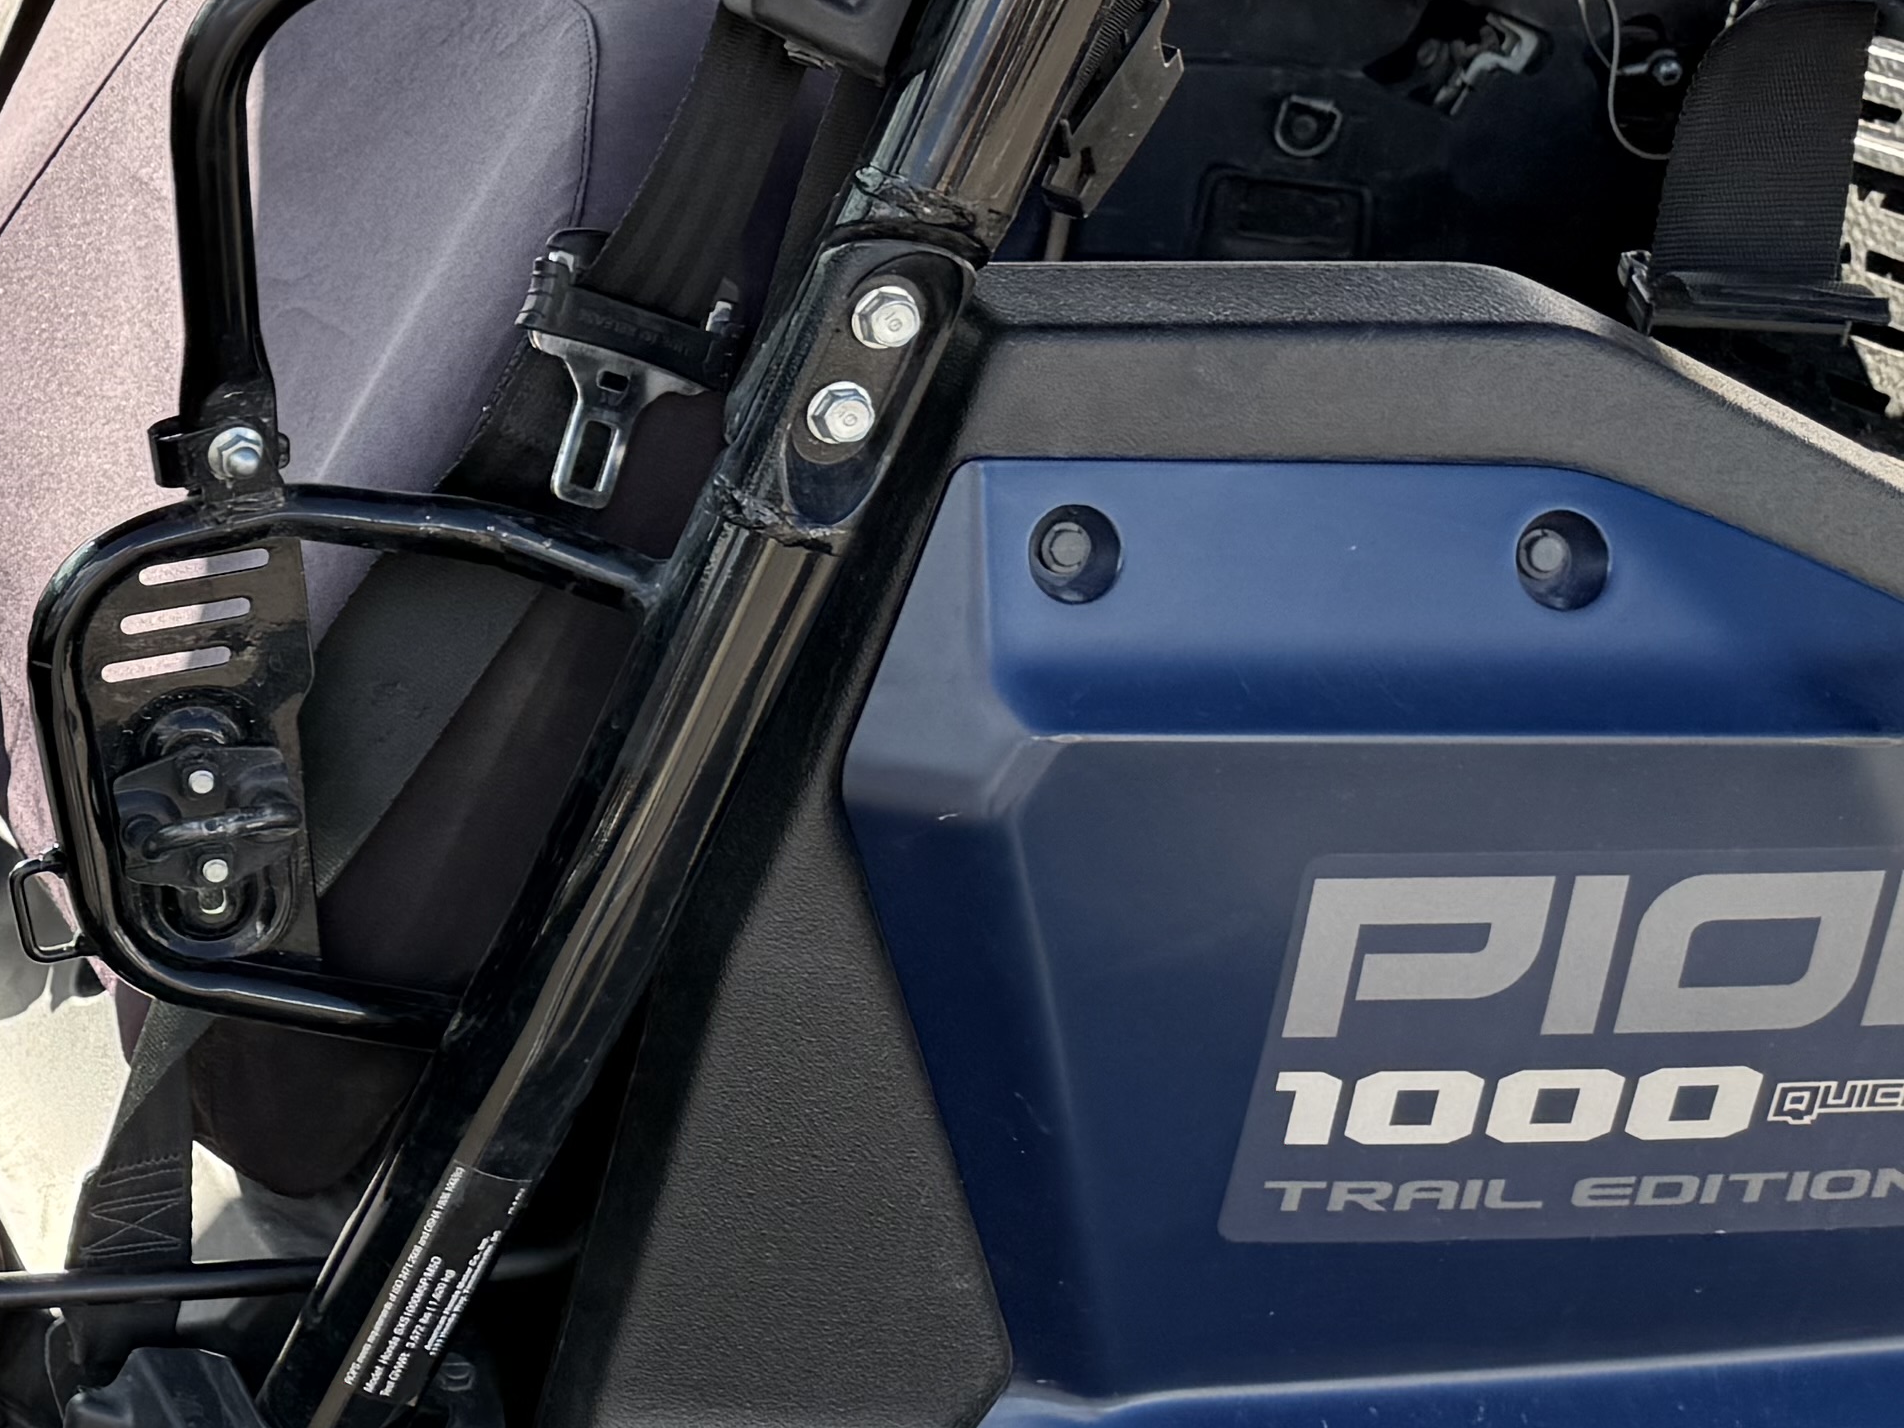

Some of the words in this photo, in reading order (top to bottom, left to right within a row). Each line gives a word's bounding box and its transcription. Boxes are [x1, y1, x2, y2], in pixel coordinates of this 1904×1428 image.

[1281, 869, 1904, 1038] PIO
[1275, 1065, 1763, 1145] 1000
[1264, 1179, 1543, 1212] TRAIL
[1571, 1169, 1904, 1209] EDITION
